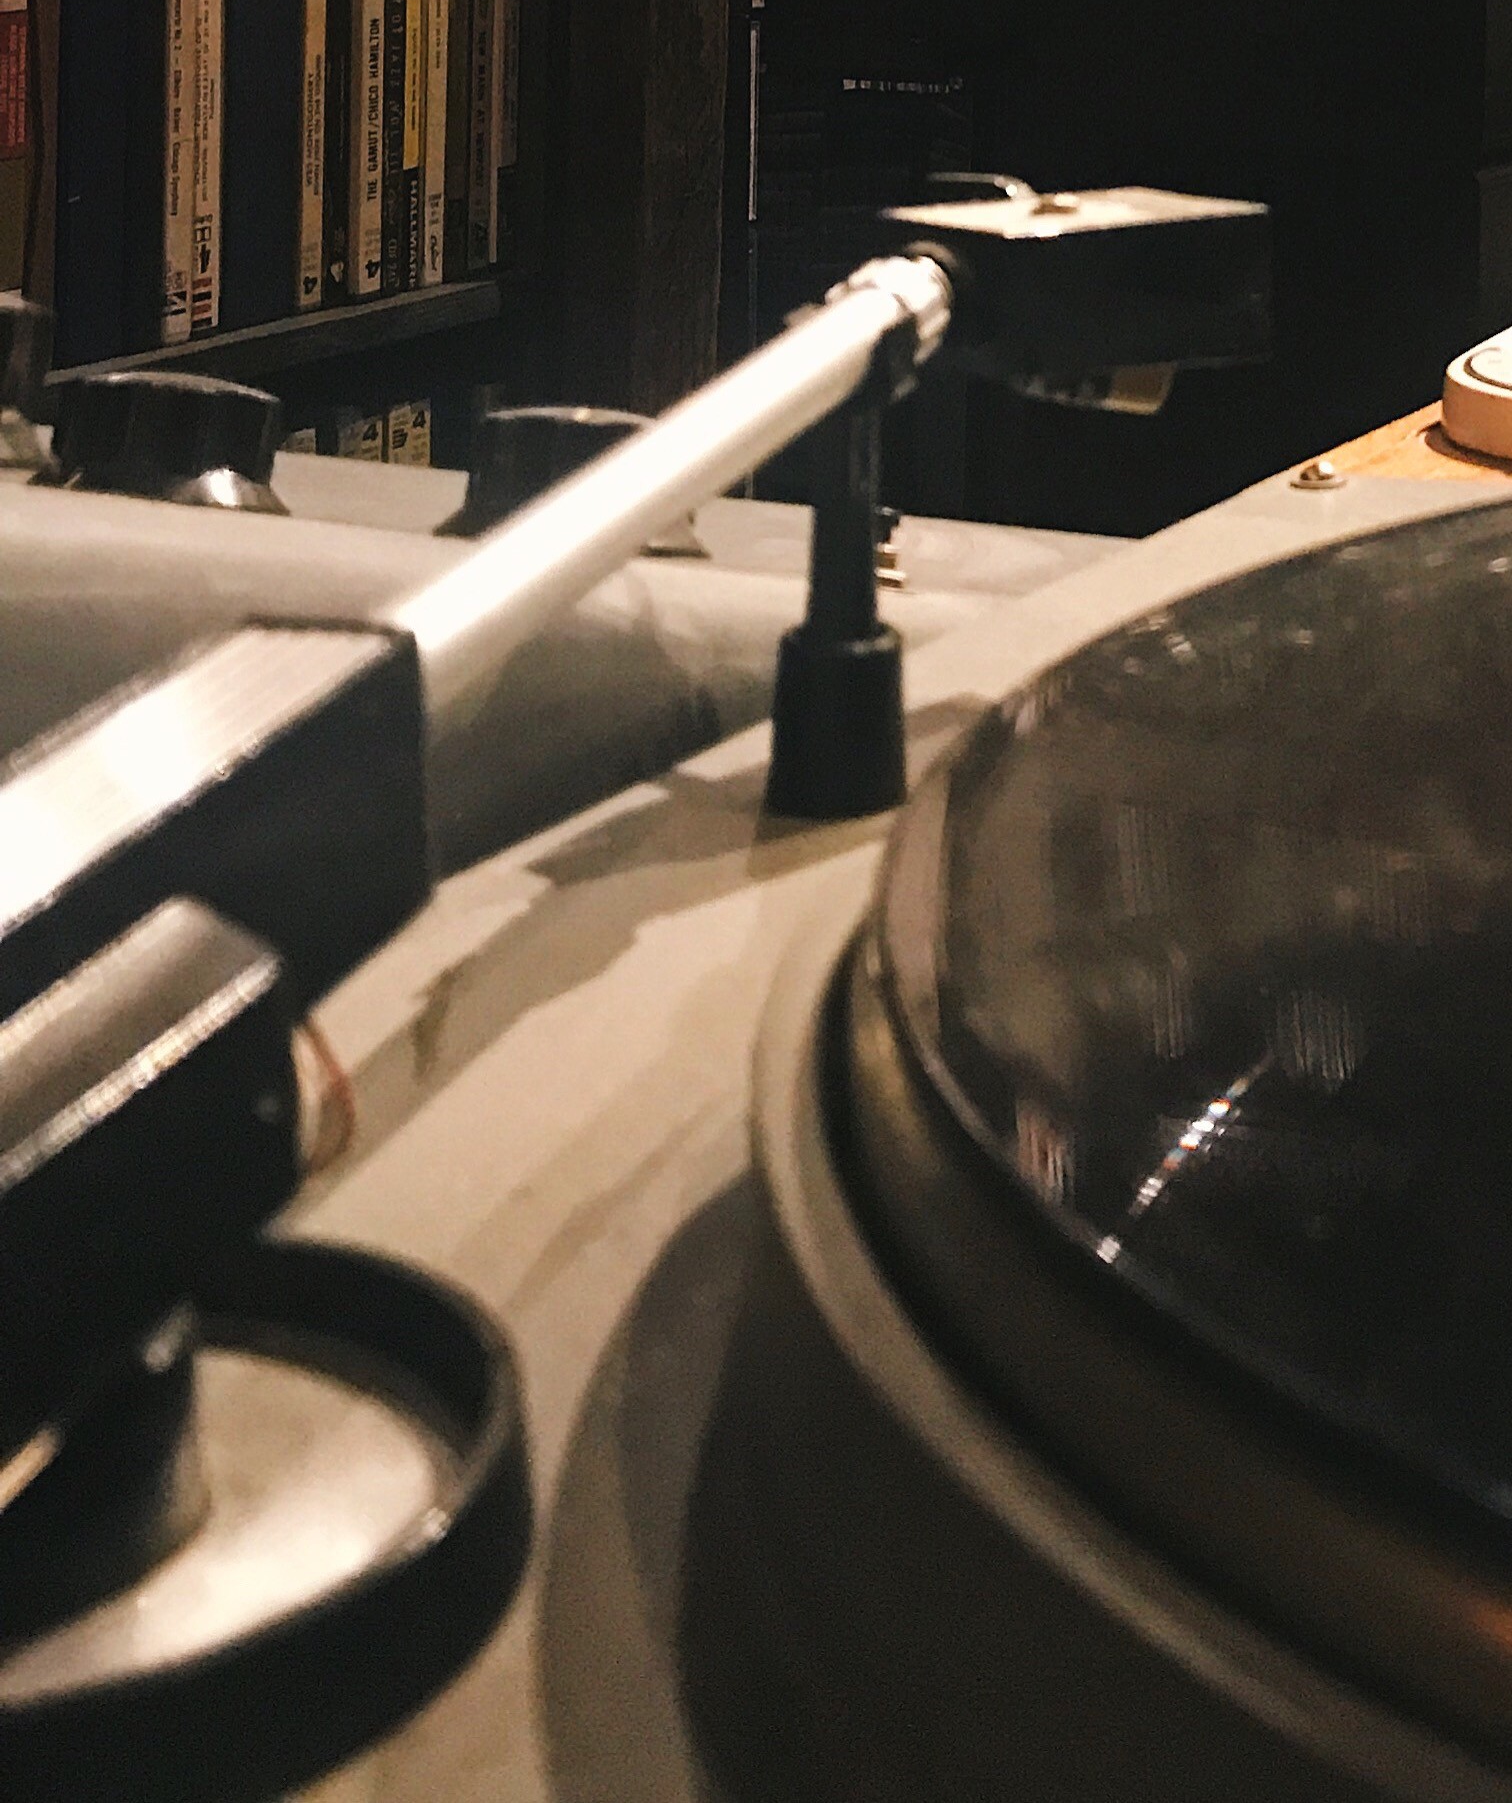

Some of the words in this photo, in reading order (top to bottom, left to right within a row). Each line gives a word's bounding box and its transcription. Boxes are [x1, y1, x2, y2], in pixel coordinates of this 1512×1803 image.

[368, 18, 380, 79] HAMILTON
[305, 72, 316, 160] MONTGOMERY
[367, 84, 380, 172] GAMUT/CHICO
[367, 178, 378, 202] THE
[366, 260, 380, 280] 4
[303, 275, 317, 295] 4
[413, 410, 426, 429] 4
[362, 423, 379, 442] 4
